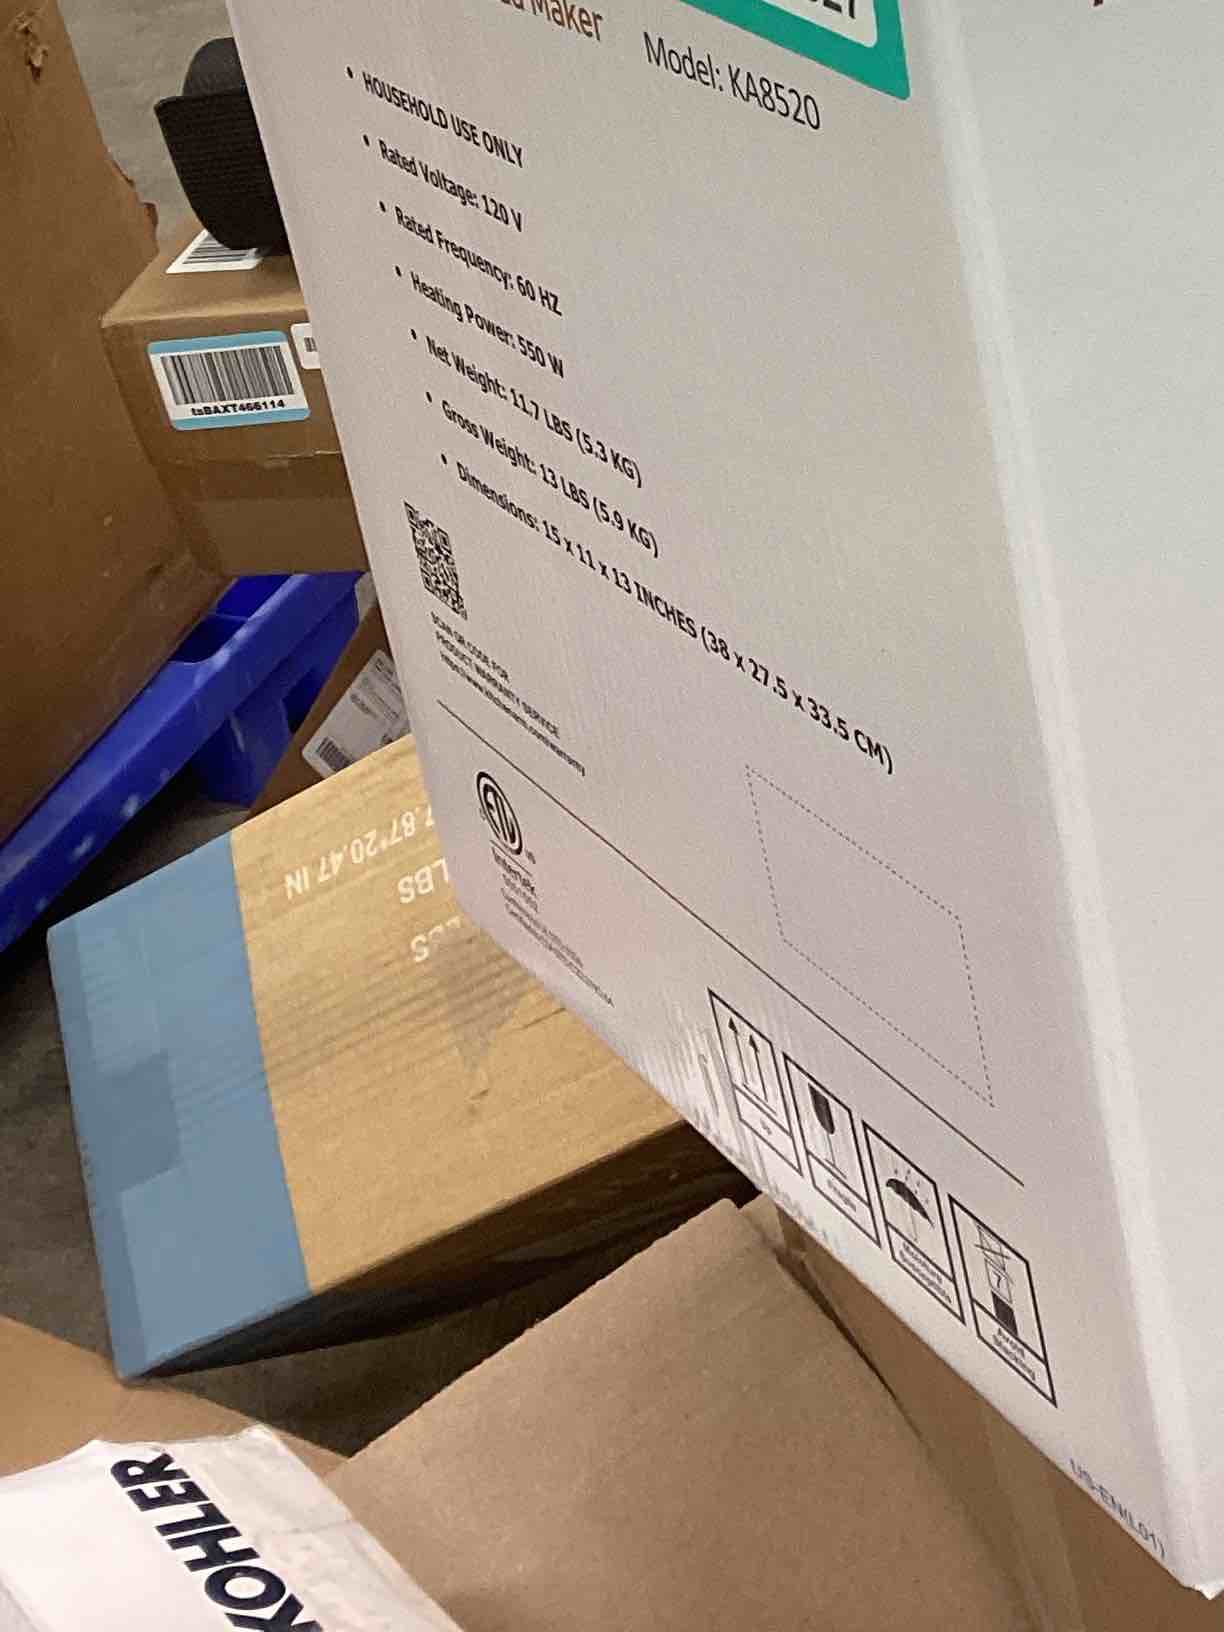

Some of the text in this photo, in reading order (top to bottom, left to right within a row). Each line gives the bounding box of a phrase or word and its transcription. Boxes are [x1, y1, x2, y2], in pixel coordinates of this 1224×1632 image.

[363, 71, 523, 169] HOUSEHOLD USE ONLY
[643, 31, 821, 130] Model: KA8520
[379, 139, 522, 232] Rated Voltage: 120 V
[395, 206, 563, 317] Rated Frequency: 60 HZ
[411, 271, 564, 378] Heating Power: 550 W
[426, 335, 643, 488] Net Weight: 11.7 LBS (5.3 KG)
[441, 399, 659, 558] Gross Weight: 13 LBS (5.9 KG)
[457, 462, 895, 776] Dimensions: 15 x 11 x 13 INCHES (38 x 27.5 x 33.5 CM)
[284, 869, 311, 900] IN
[110, 1453, 325, 1632] KOHLER
